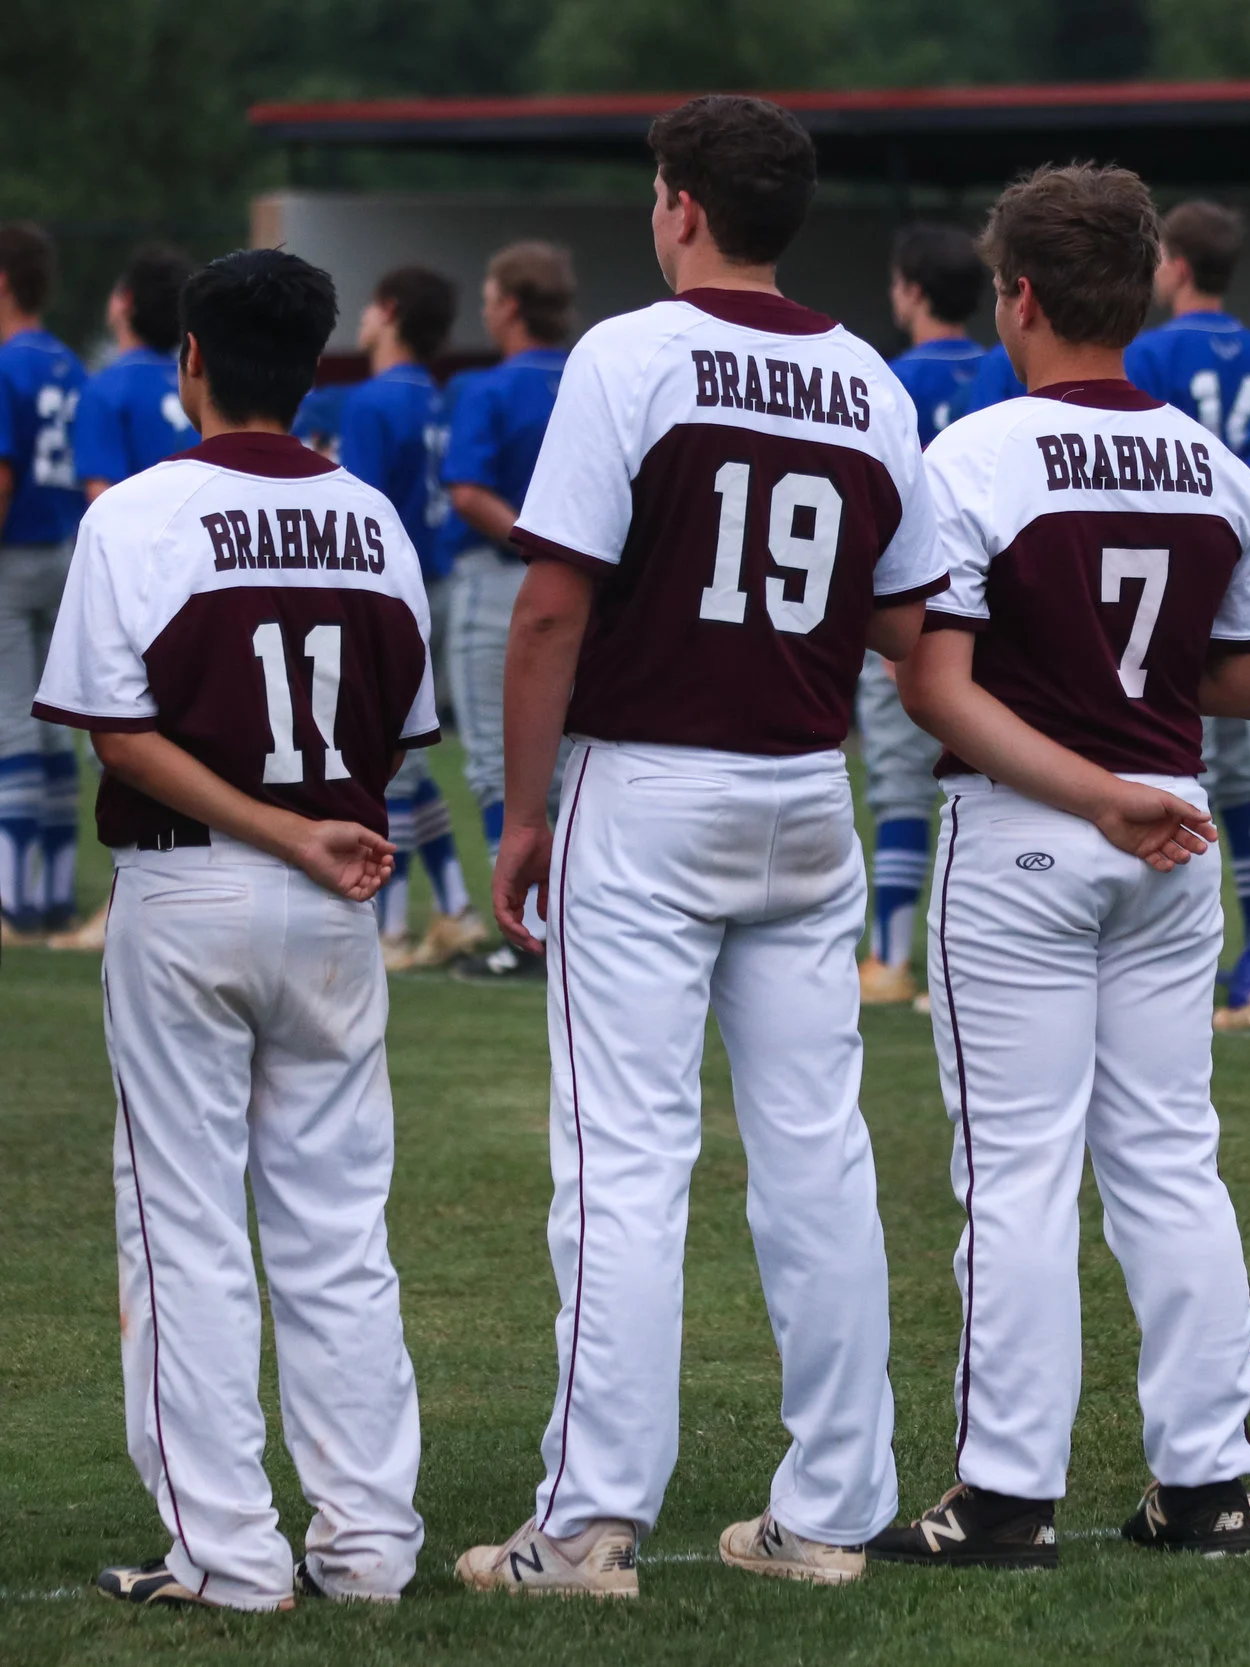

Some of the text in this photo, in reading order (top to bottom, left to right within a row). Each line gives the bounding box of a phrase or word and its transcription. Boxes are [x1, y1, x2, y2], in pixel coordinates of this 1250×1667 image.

[690, 349, 870, 433] BRAHMAS
[1036, 433, 1214, 498] BRAHMAS
[200, 508, 386, 576] BRAHMAS
[699, 461, 843, 635] 19
[1101, 547, 1170, 699] 7
[251, 622, 352, 784] 11
[510, 1541, 544, 1582] N
[920, 1508, 967, 1553] N
